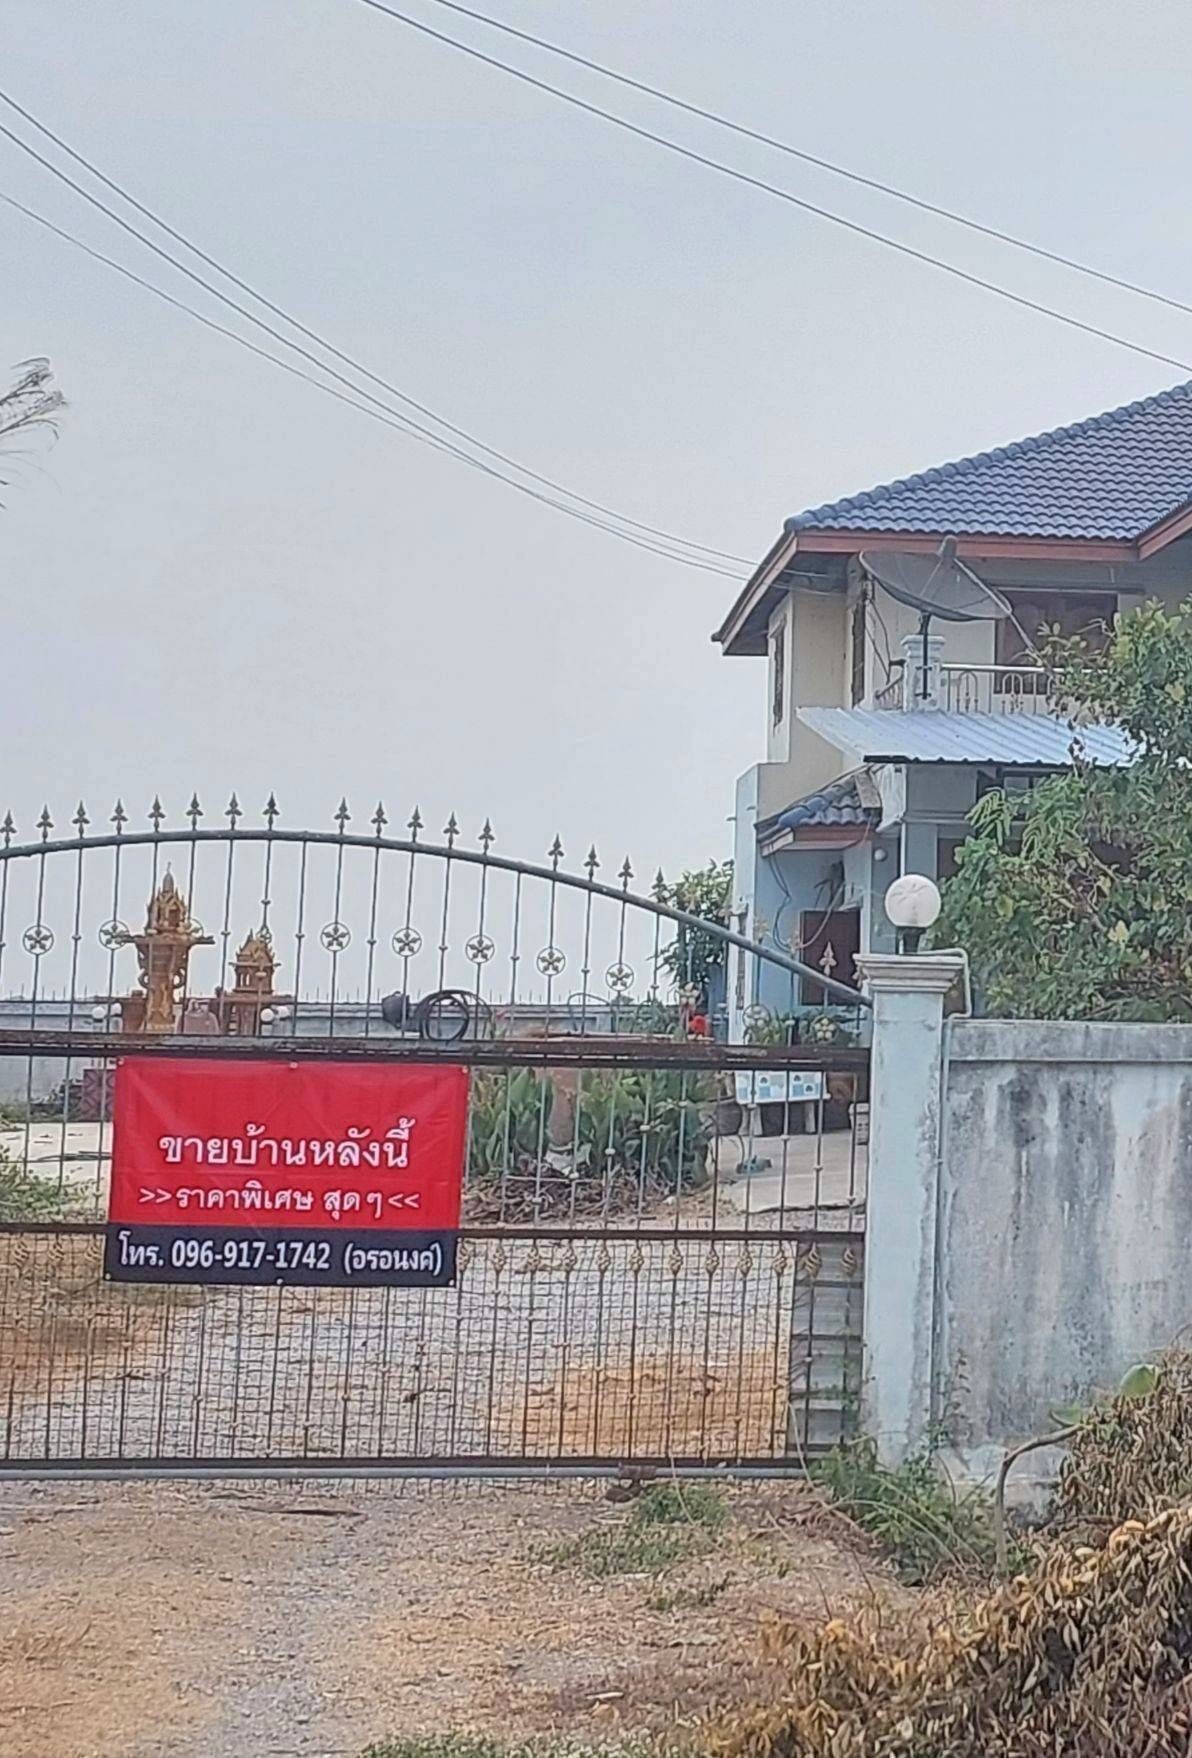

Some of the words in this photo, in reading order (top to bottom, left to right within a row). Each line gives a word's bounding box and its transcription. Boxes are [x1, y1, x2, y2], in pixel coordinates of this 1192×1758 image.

[158, 1117, 416, 1168] ขายบ้านหลังนี้
[118, 1230, 163, 1266] โทร.
[171, 1239, 331, 1268] 096-917-1742
